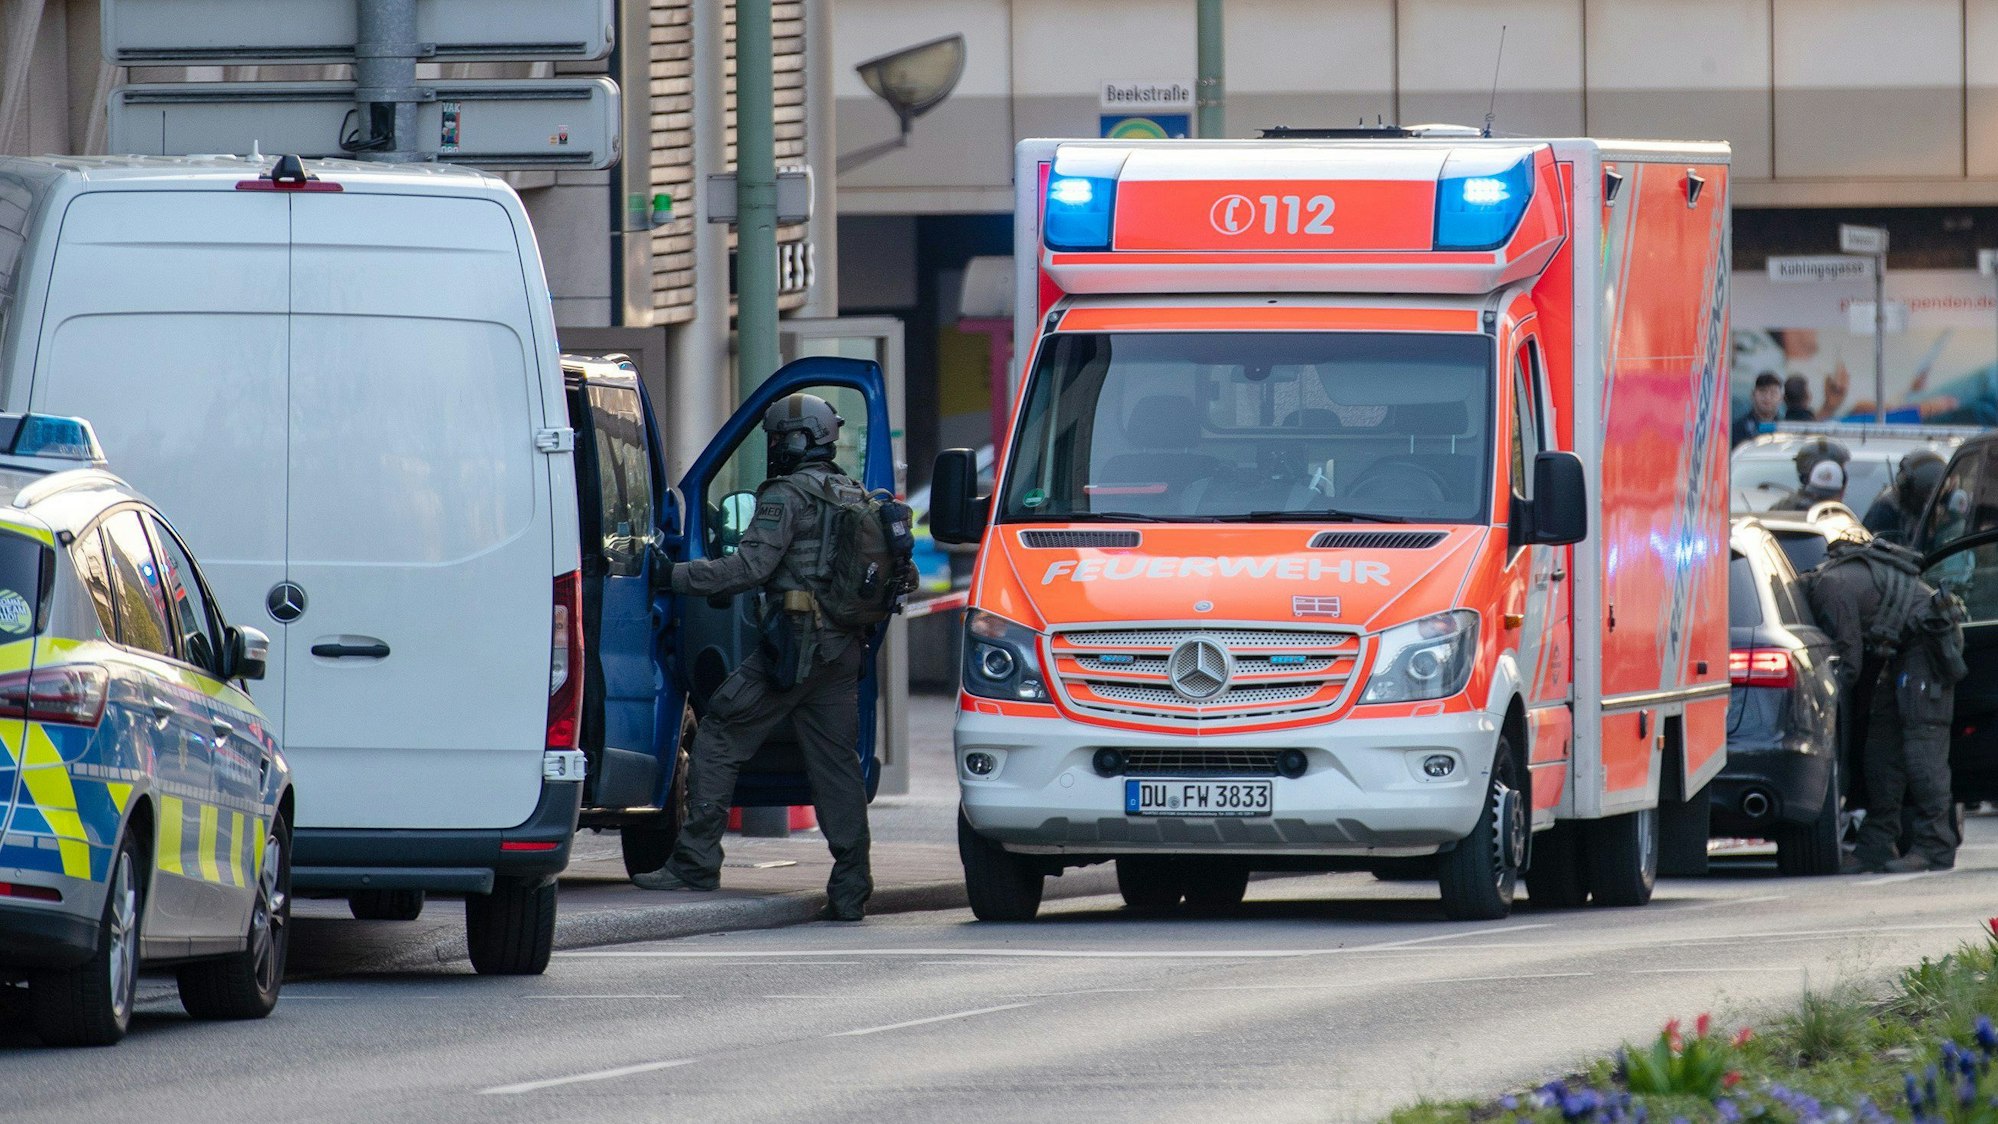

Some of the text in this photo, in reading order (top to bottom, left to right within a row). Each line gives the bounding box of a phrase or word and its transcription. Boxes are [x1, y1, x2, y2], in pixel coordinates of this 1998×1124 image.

[1107, 84, 1189, 101] Beekstraße
[1260, 195, 1335, 234] 112
[777, 243, 815, 290] ESS
[760, 506, 782, 516] MED
[1042, 557, 1391, 586] FEUERWEHR
[1141, 785, 1267, 807] DU FW 3833
